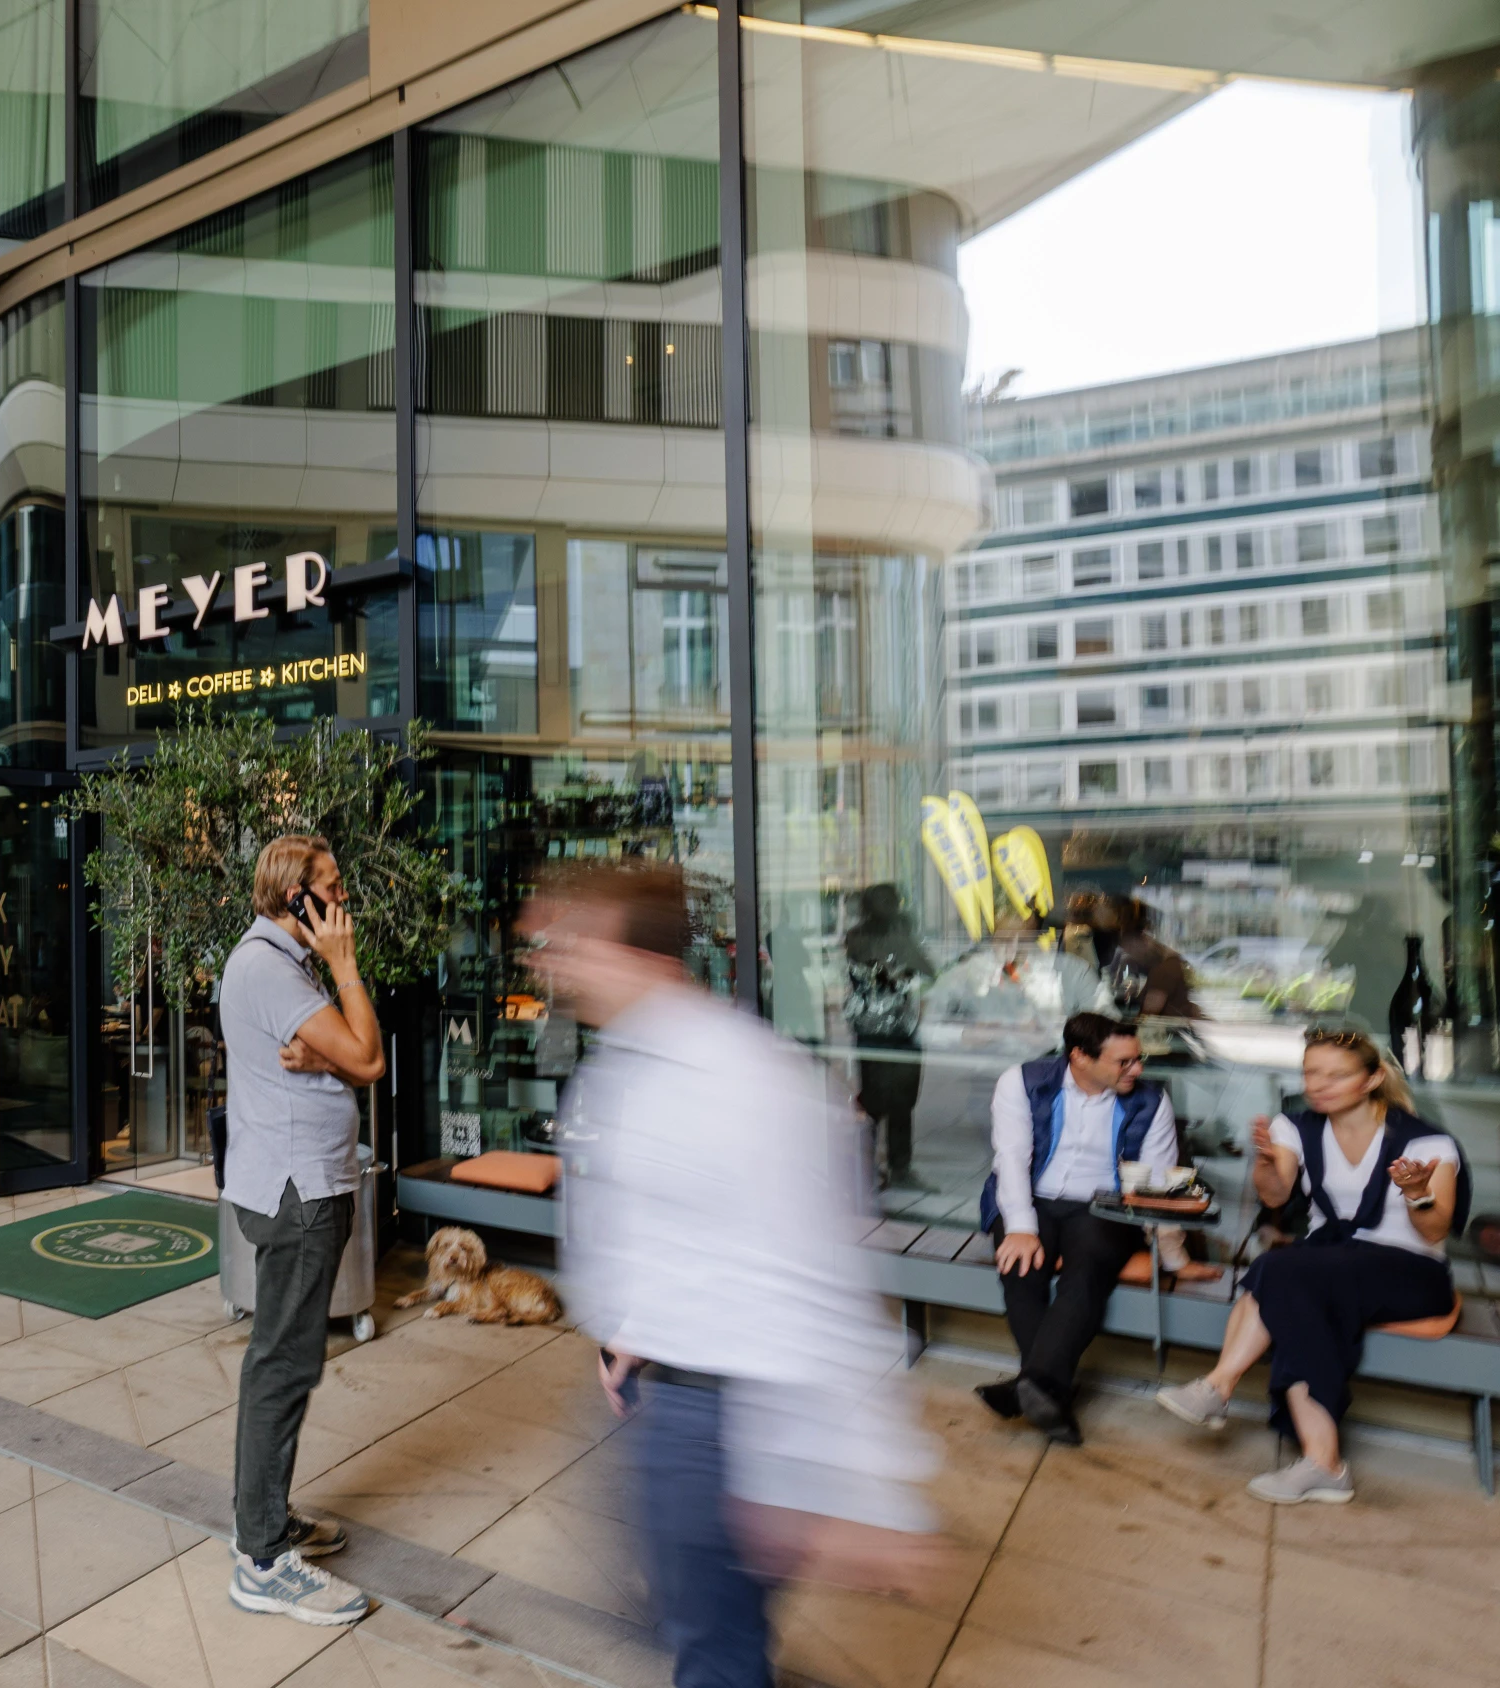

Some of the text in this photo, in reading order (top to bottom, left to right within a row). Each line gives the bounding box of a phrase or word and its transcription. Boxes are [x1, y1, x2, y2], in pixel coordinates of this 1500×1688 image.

[82, 551, 329, 651] MEYER
[126, 651, 367, 707] DELI COFFEE KITCHEN
[446, 1016, 473, 1045] M
